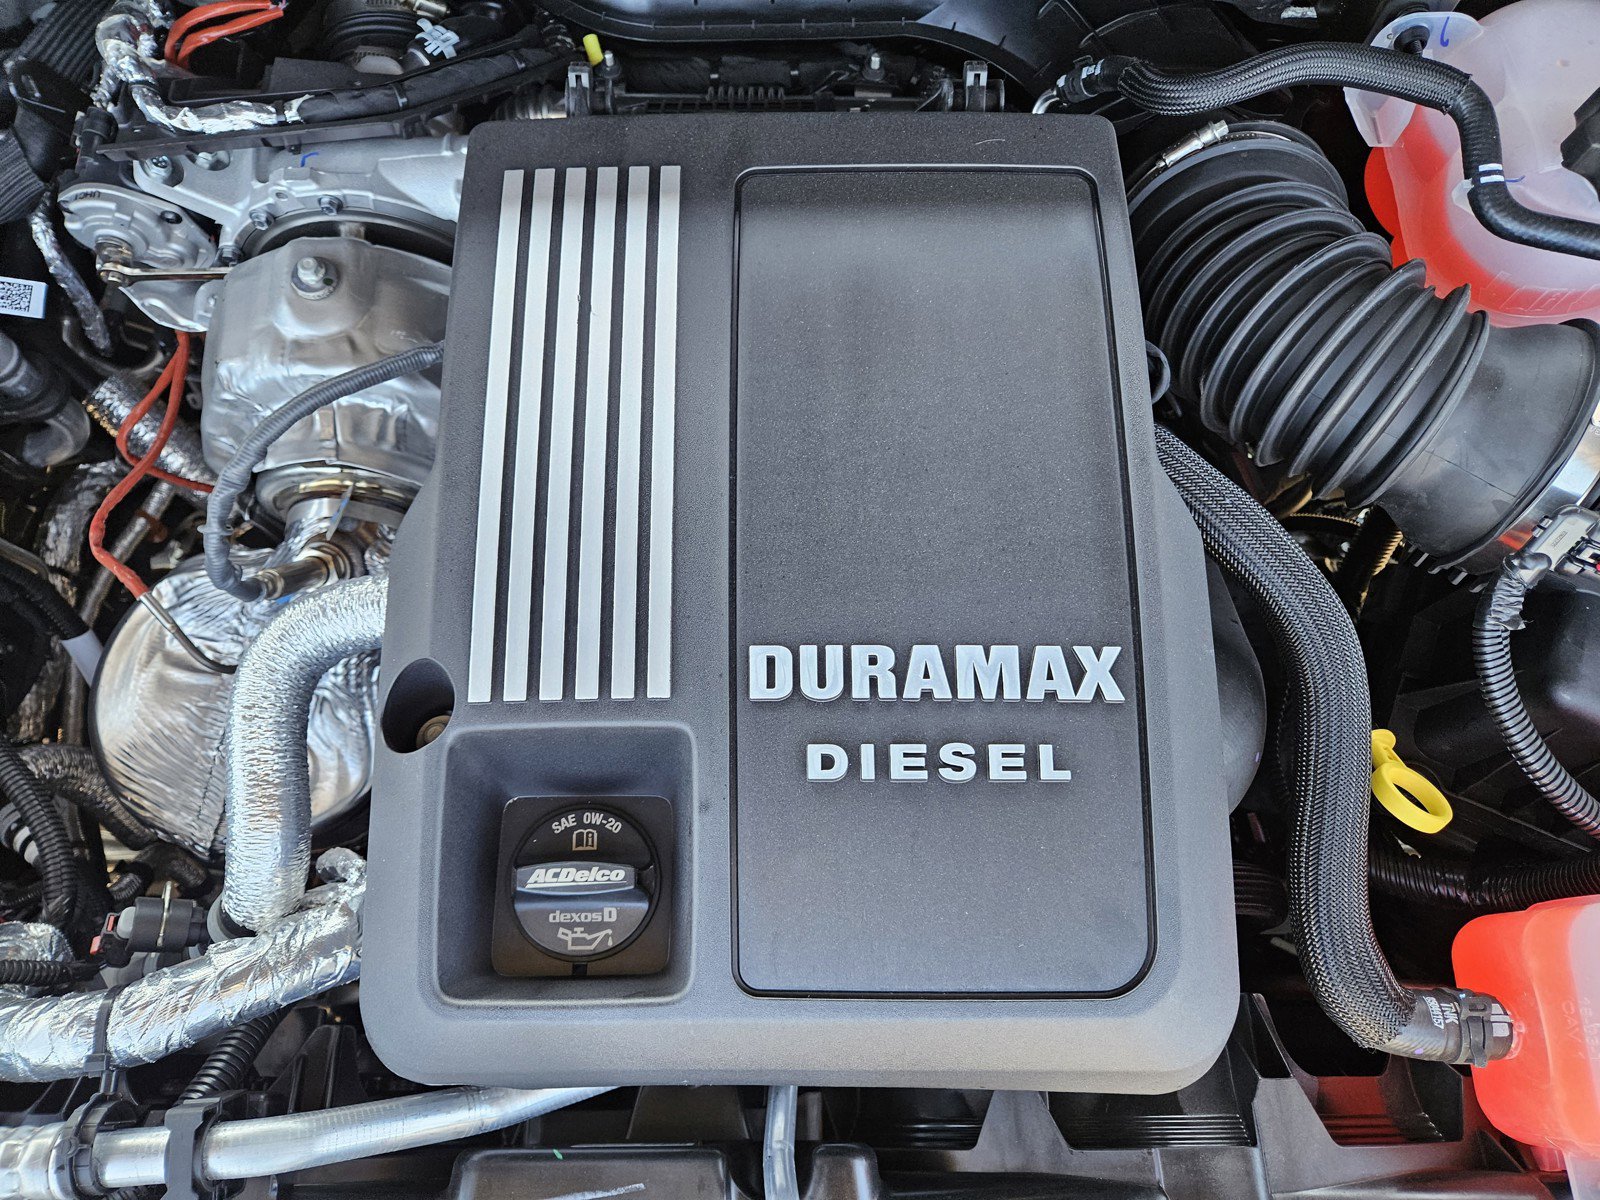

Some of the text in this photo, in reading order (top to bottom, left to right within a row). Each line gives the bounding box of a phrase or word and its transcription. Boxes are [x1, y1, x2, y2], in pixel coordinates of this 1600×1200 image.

[748, 644, 1126, 703] DURAMAX
[806, 742, 1073, 784] DIESEL
[551, 811, 622, 834] SAE 0W-20
[526, 866, 626, 883] ACDelco
